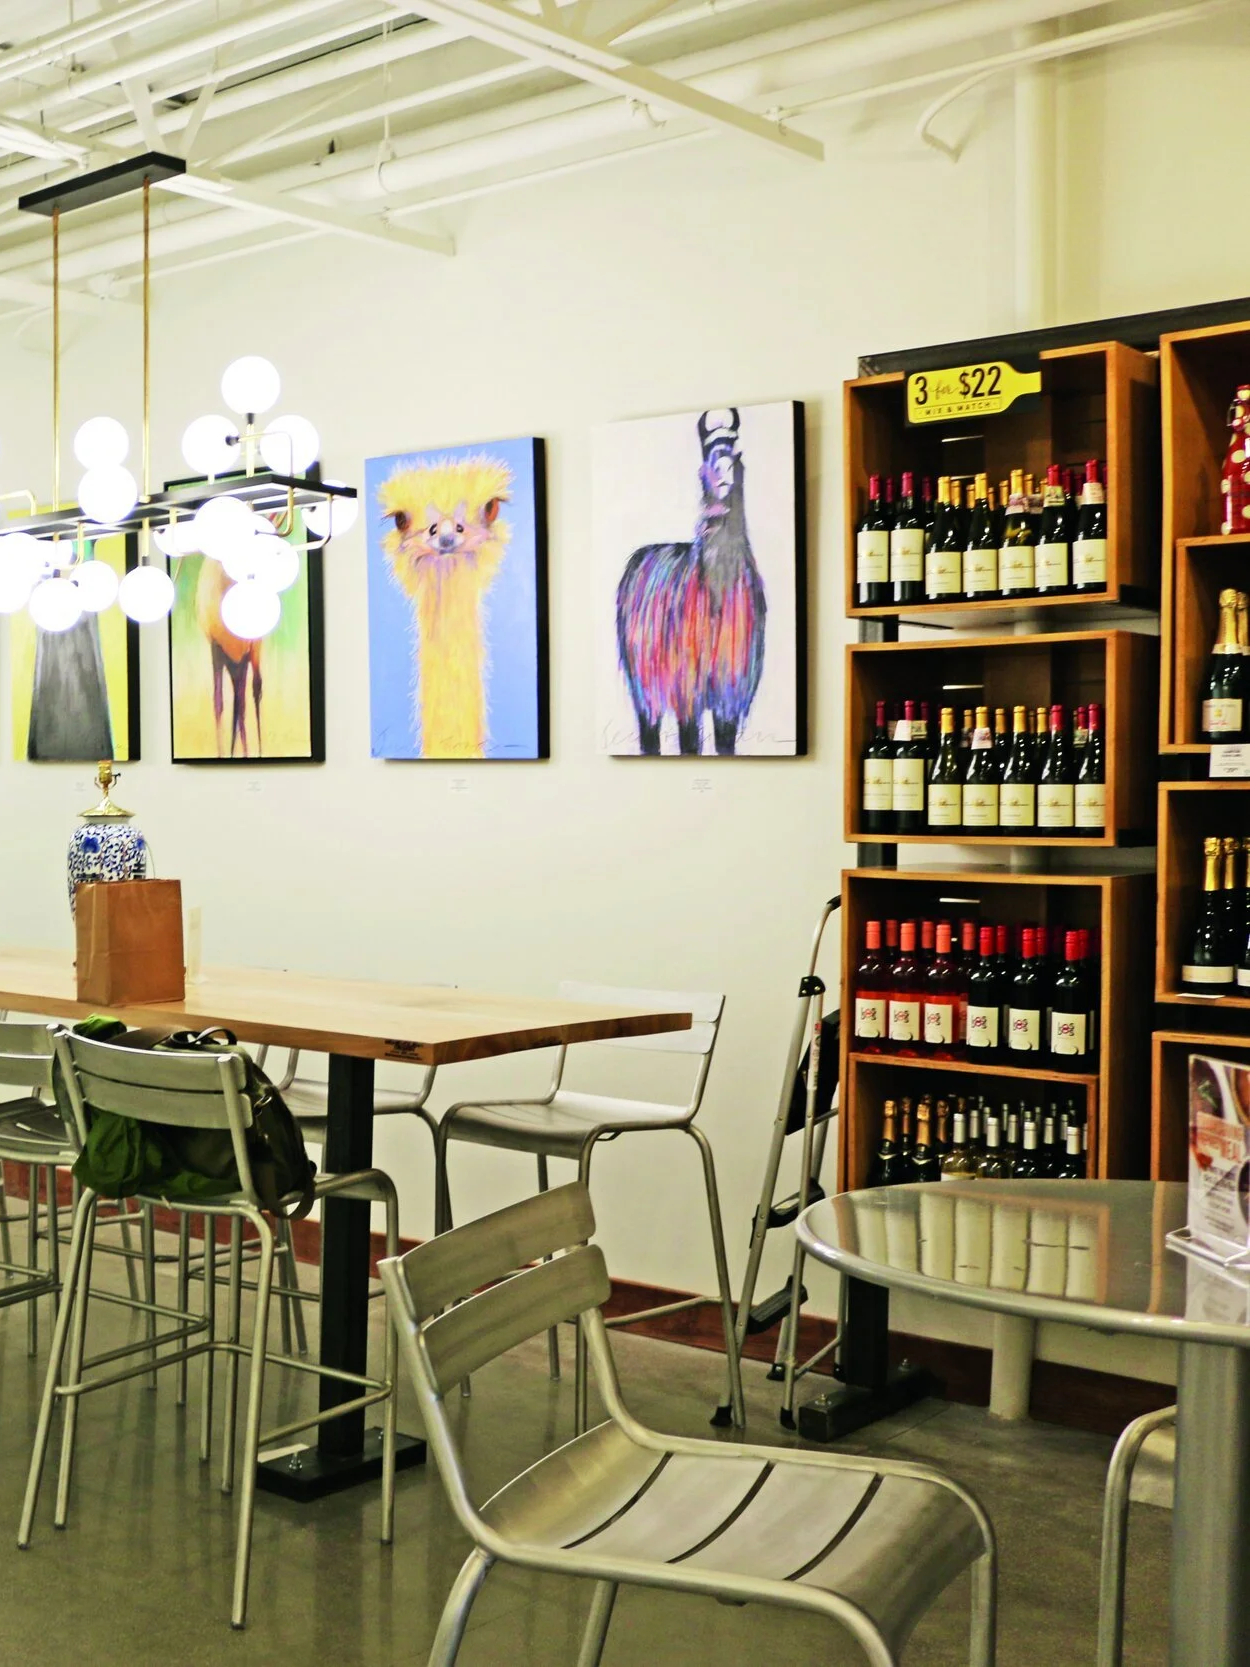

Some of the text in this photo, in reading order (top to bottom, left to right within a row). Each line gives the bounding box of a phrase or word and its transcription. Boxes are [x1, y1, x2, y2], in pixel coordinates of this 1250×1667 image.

[915, 365, 1001, 405] 3 for $22
[957, 401, 991, 411] MATCH
